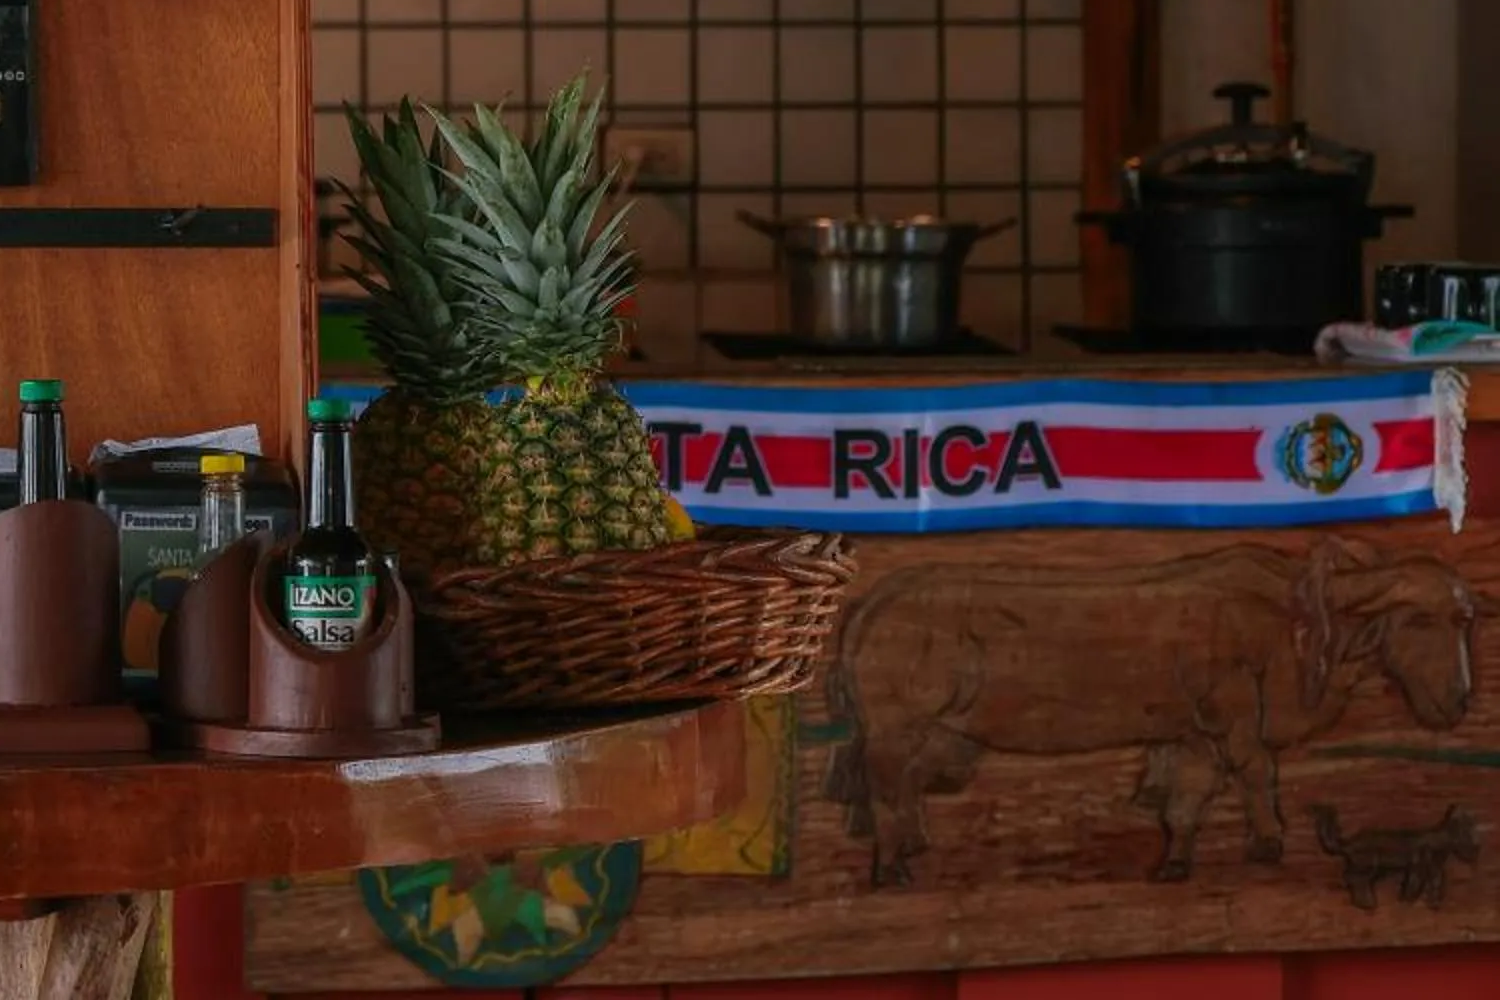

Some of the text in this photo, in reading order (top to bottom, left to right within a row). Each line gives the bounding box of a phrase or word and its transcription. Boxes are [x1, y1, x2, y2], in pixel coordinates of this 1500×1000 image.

[646, 420, 1063, 500] TA RICA
[292, 619, 355, 643] Salsa
